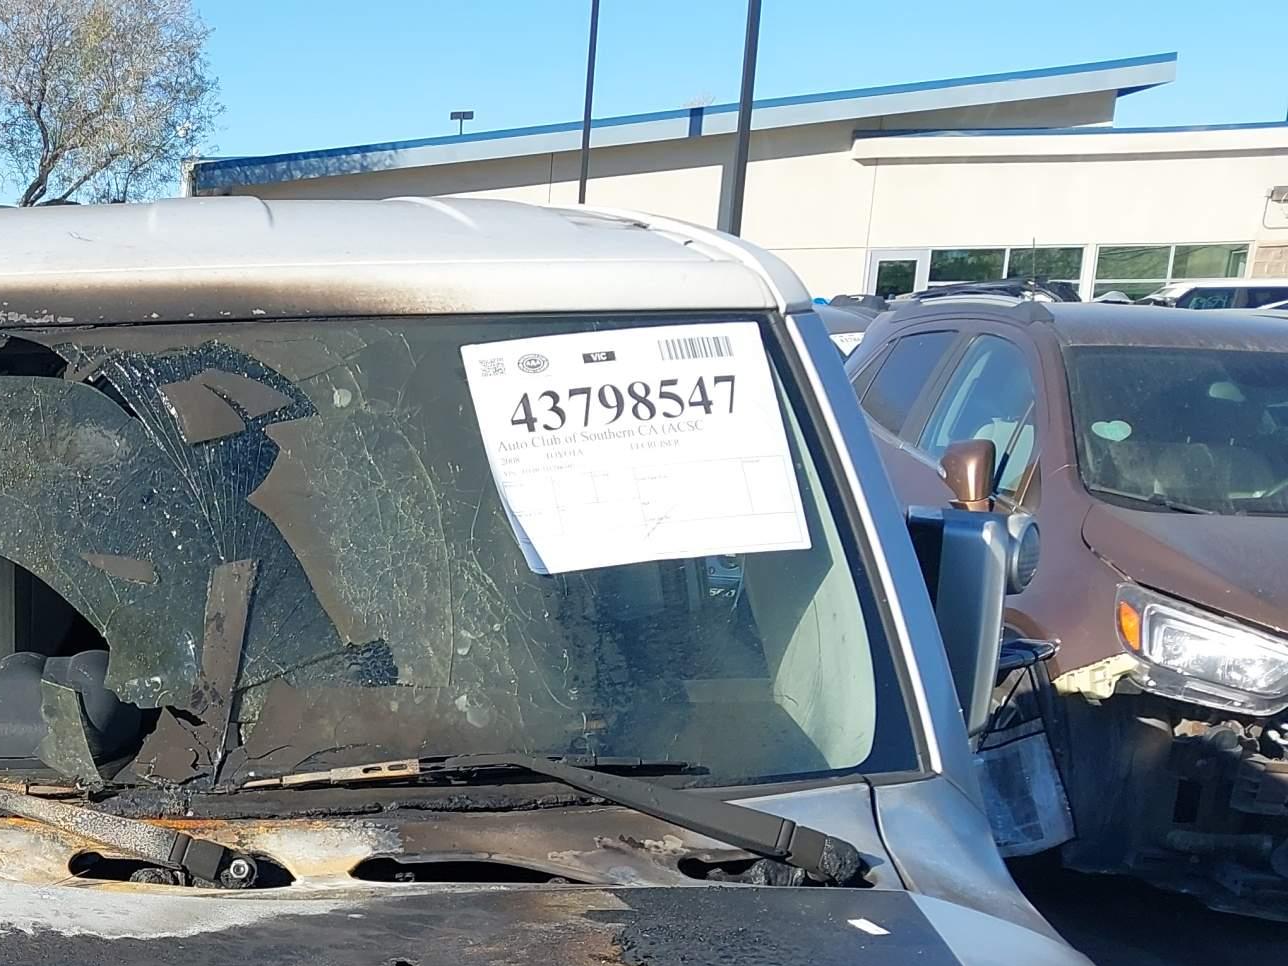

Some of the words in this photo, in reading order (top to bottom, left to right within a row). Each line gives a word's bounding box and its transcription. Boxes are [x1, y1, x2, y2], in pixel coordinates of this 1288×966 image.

[590, 352, 607, 361] VIC
[510, 375, 736, 433] 43798547
[497, 441, 528, 453] Auto
[531, 434, 561, 448] Club
[564, 433, 578, 444] of
[580, 427, 635, 442] Southern
[638, 424, 658, 436] CA
